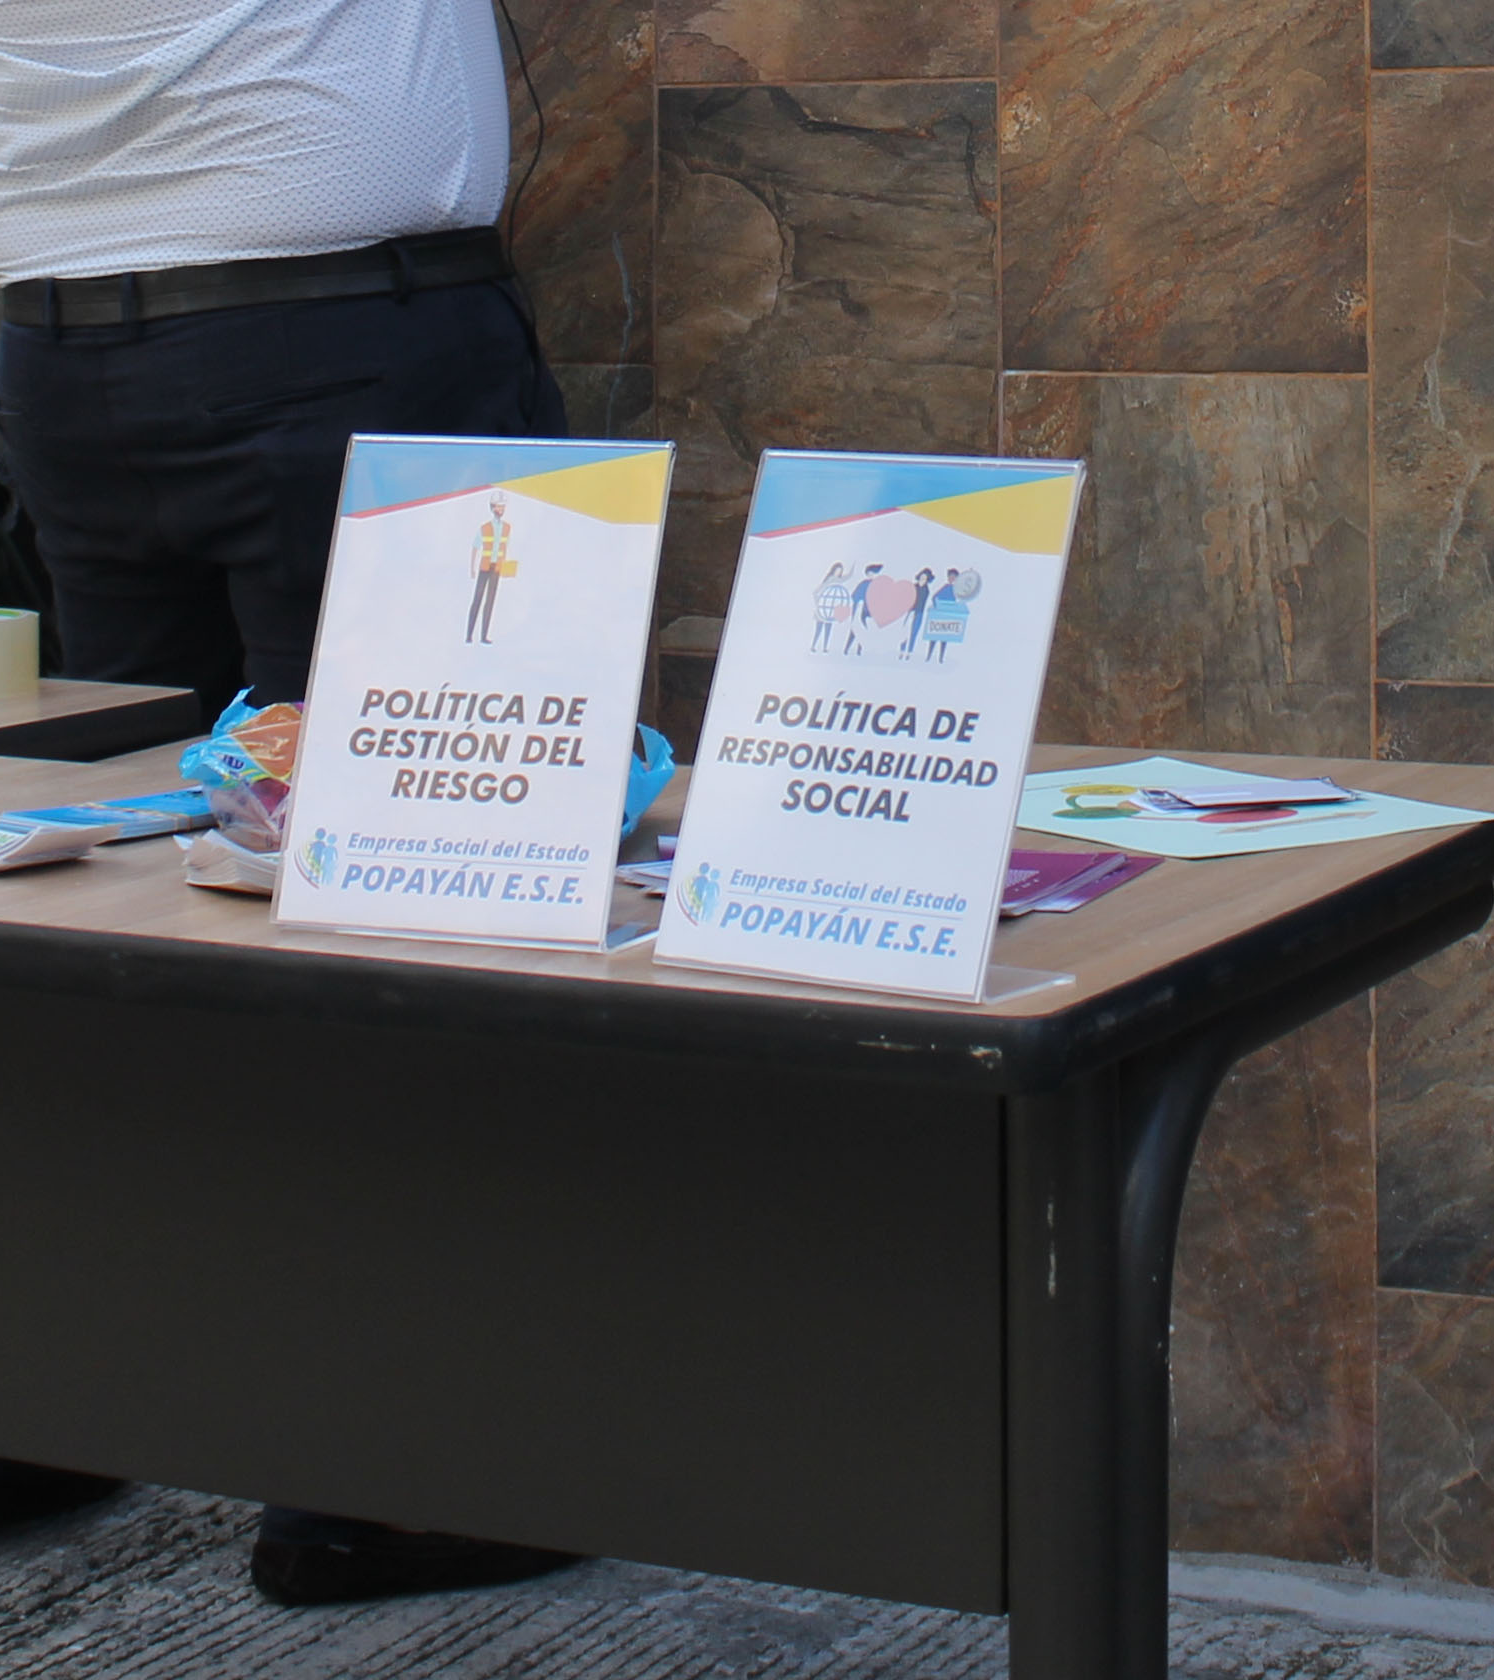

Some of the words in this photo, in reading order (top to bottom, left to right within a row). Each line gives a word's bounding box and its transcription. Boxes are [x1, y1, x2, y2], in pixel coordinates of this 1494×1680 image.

[929, 621, 961, 633] DONATE
[359, 683, 525, 724] POLÍTICA
[537, 694, 588, 727] DE
[754, 691, 917, 739] POLÍTICA
[928, 708, 980, 745] DE
[349, 723, 510, 764] GESTIÓN
[520, 735, 586, 768] DEL
[716, 735, 999, 789] RESPONSABILIDAD
[390, 769, 530, 806] RIESGO
[781, 779, 912, 823] SOCIAL
[347, 832, 428, 855] Empresa
[431, 835, 487, 857] Social
[492, 839, 523, 859] del
[525, 842, 590, 863] Estado
[340, 862, 494, 898] POPAYÁN
[500, 873, 585, 905] E.S.E.
[729, 869, 808, 896] Empresa
[811, 876, 866, 902] Social
[872, 882, 900, 906] del
[903, 887, 967, 913] Estado
[719, 901, 872, 946] POPAYÁN
[876, 920, 958, 958] E.S.E.
